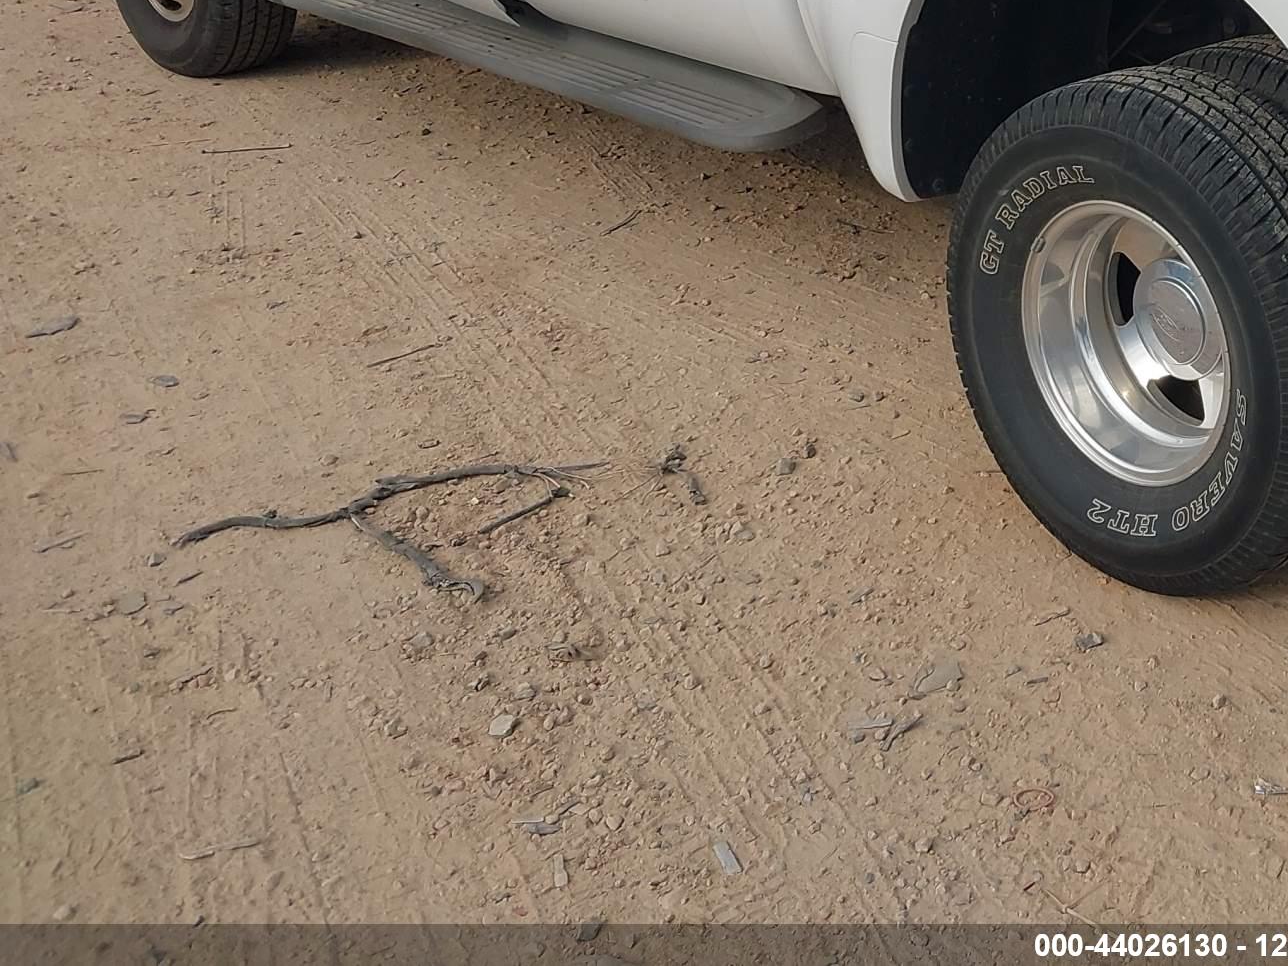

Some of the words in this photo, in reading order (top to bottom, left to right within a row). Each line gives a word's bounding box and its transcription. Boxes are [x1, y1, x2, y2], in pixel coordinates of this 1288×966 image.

[979, 229, 1005, 275] GT
[994, 165, 1095, 231] RADIAL
[1170, 388, 1248, 532] SAVERO
[1086, 498, 1159, 537] HT2
